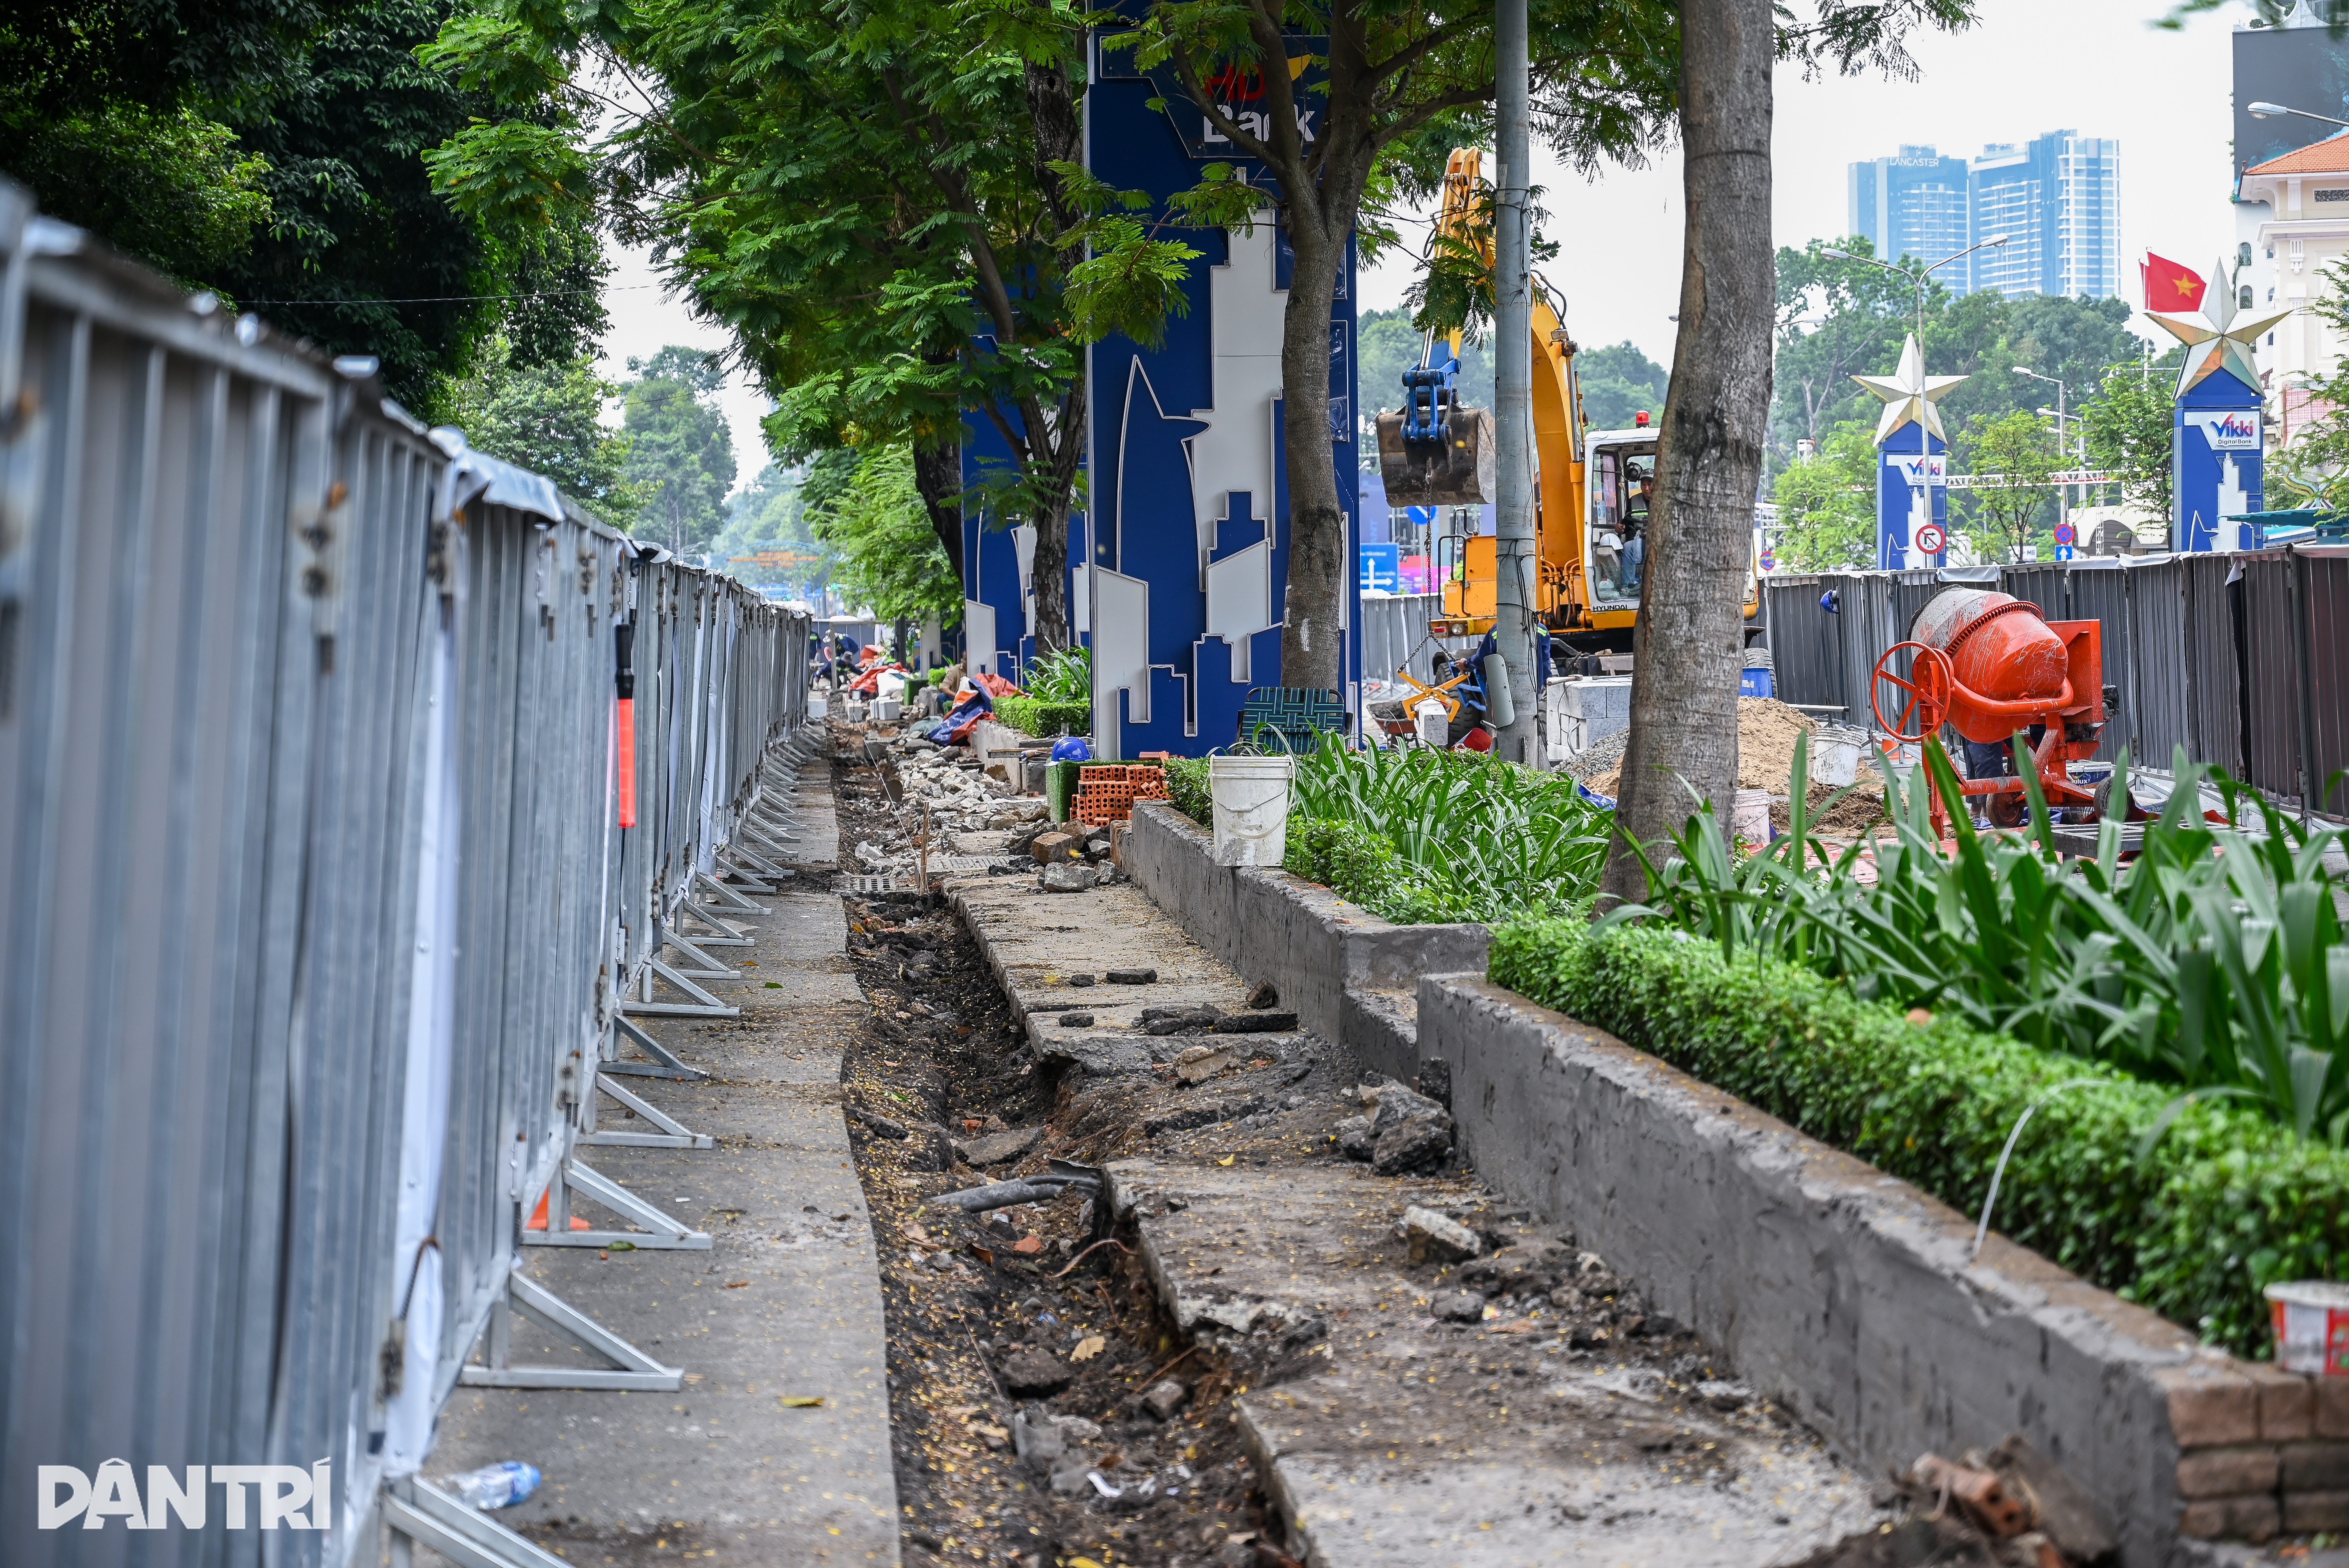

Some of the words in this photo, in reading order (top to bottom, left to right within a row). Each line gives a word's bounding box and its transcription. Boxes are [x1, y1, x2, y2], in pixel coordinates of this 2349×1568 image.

[1889, 157, 1939, 167] LANCASTER
[2210, 413, 2254, 437] Vikki
[1907, 457, 1941, 476] Viki
